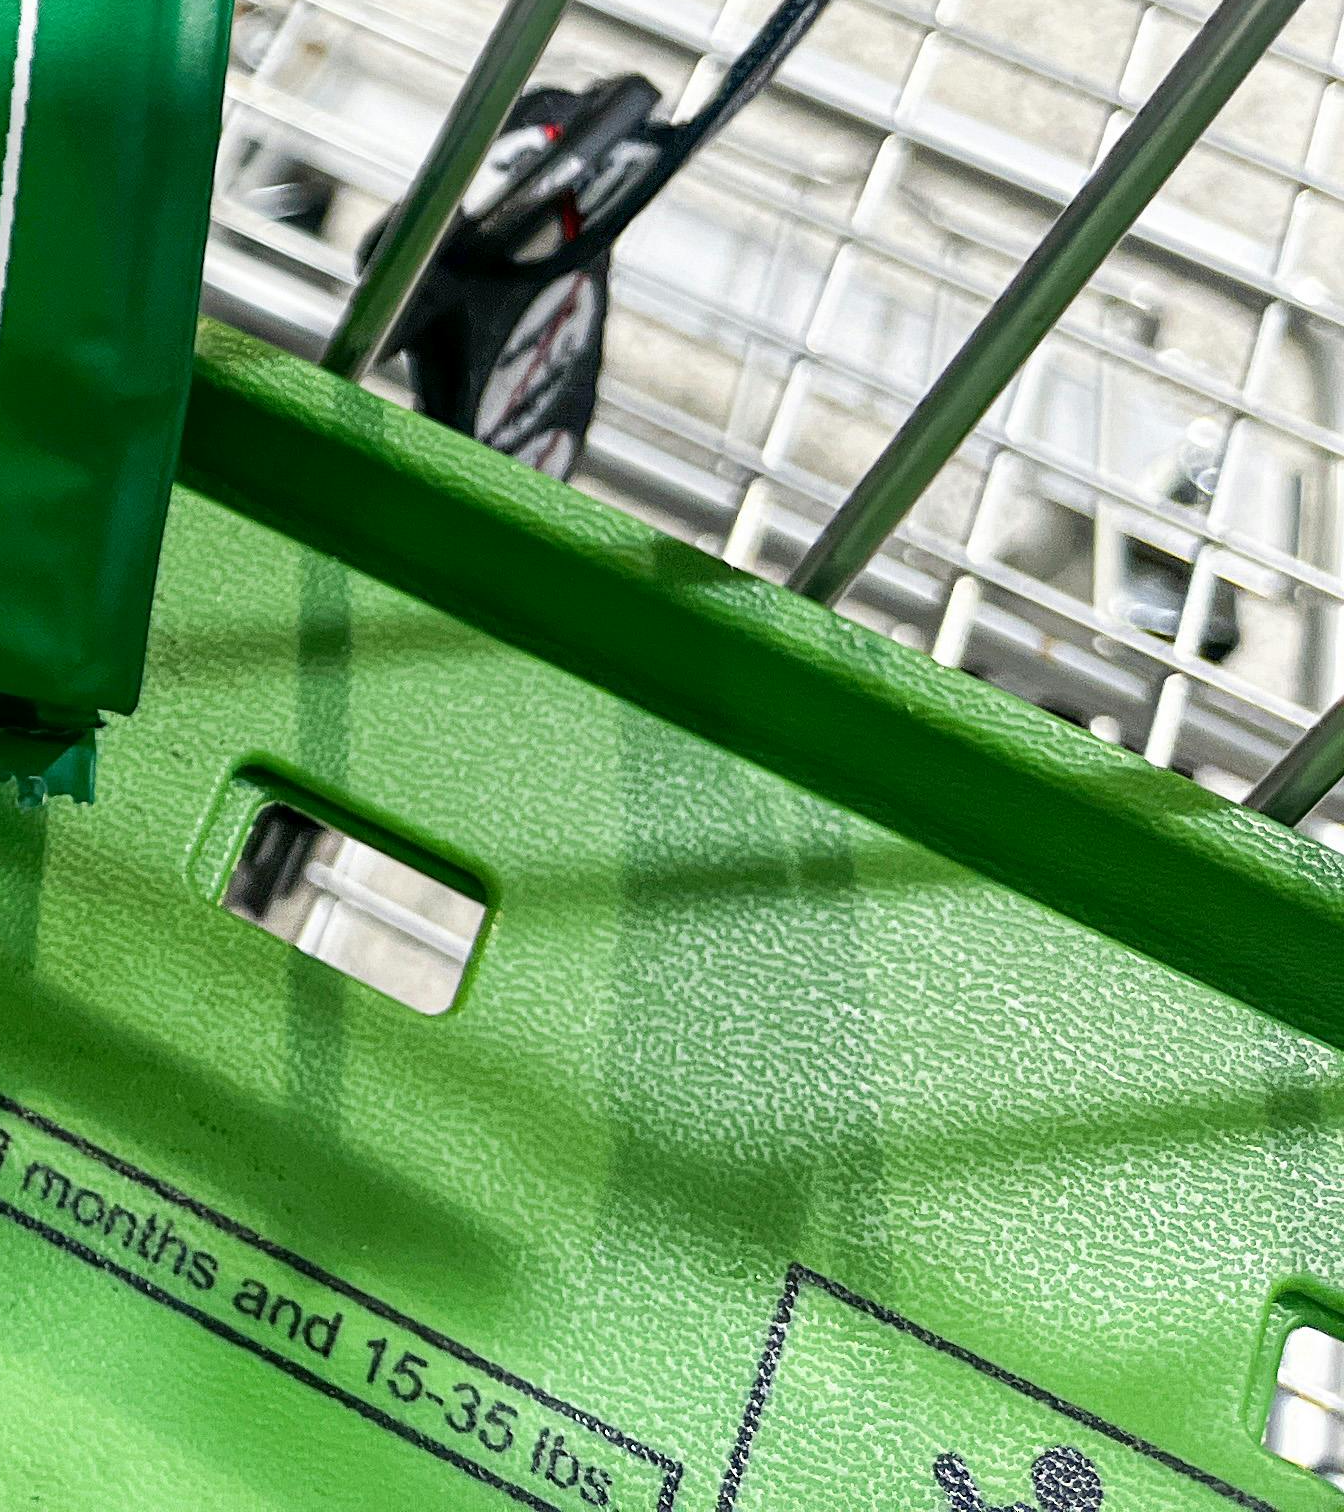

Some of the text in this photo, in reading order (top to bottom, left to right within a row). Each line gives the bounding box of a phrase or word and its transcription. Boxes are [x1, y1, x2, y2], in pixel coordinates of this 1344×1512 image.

[18, 1160, 221, 1293] months
[231, 1275, 345, 1359] and
[365, 1336, 519, 1454] 15-35
